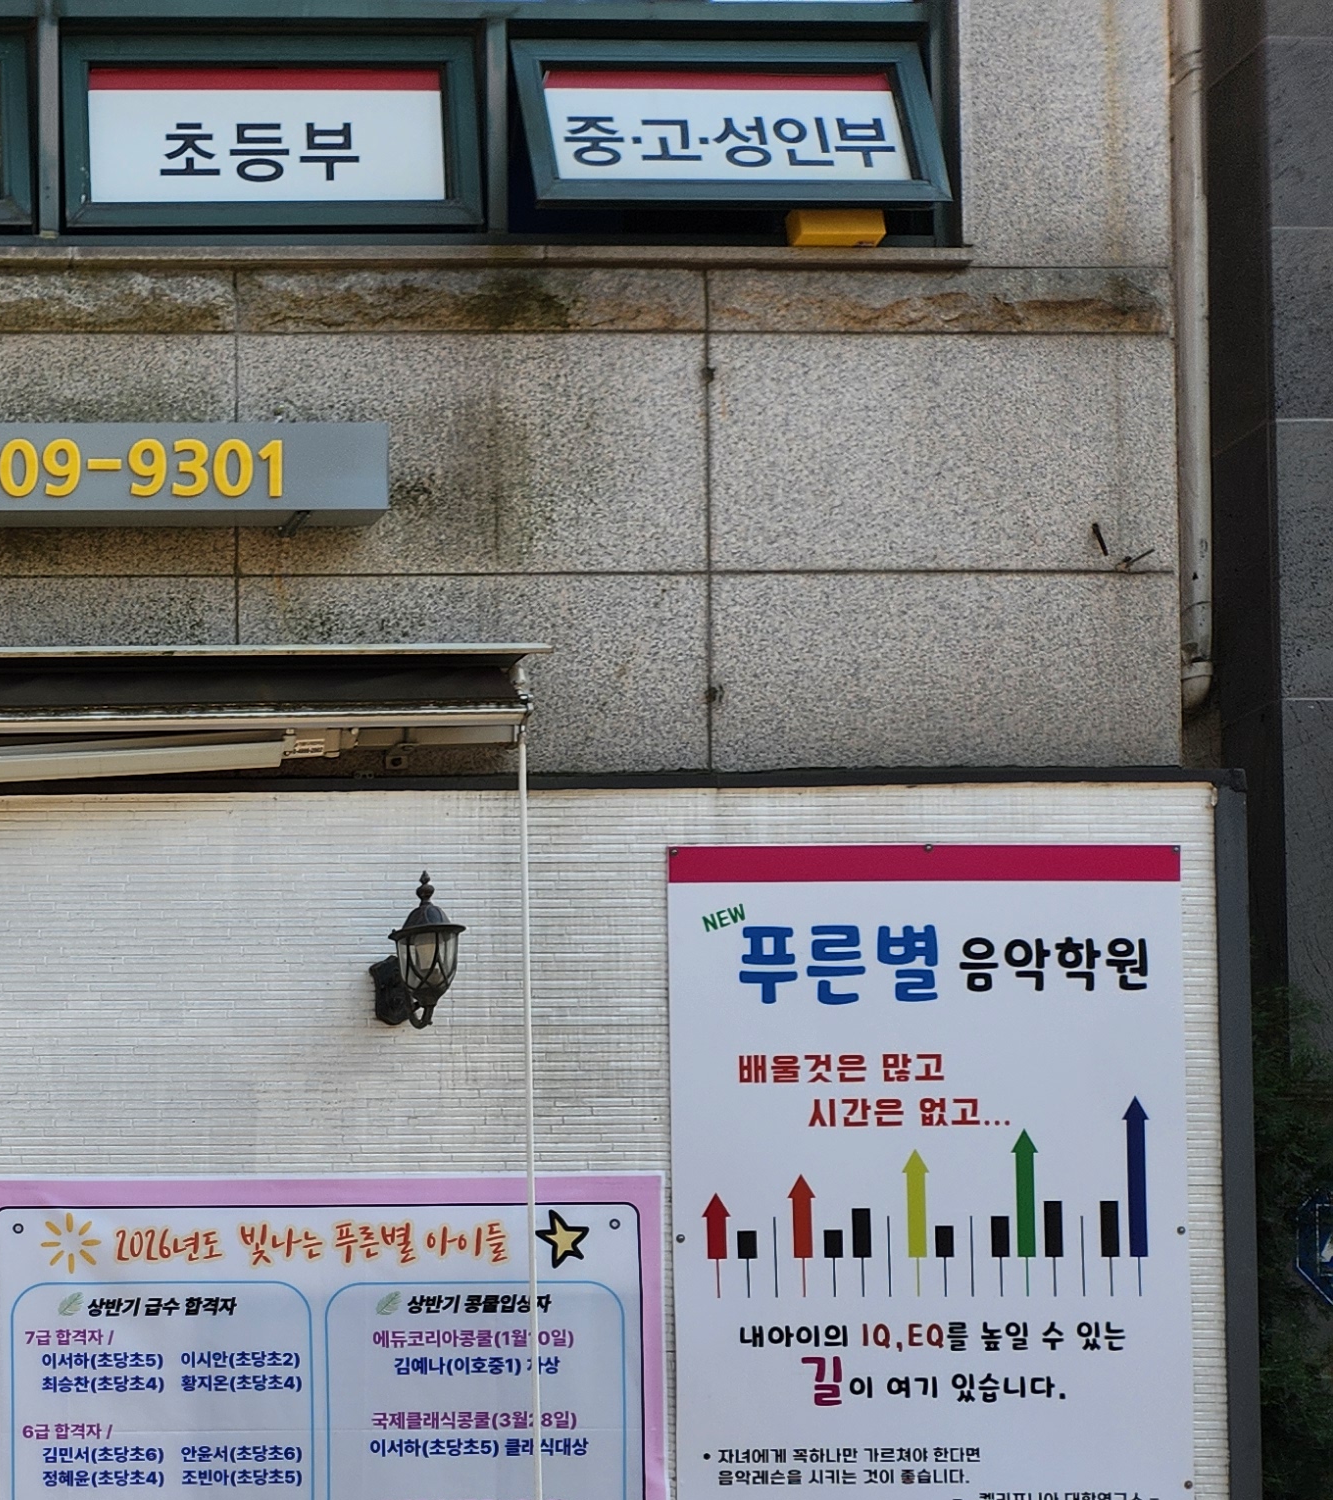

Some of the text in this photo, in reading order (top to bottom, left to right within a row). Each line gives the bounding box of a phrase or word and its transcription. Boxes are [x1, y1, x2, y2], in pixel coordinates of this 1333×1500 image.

[160, 123, 359, 182] 초등부
[702, 904, 746, 932] NEW
[739, 925, 1148, 1005] 푸른별 음악학원
[739, 1054, 944, 1083] 배울것은 많고
[809, 1098, 1010, 1127] 시간은 없고...
[115, 1223, 508, 1264] 2026년도 빛나는 푸른별 아이들
[87, 1297, 237, 1316] 상반기 급수 합격자
[407, 1295, 460, 1313] 상반기
[25, 1329, 103, 1345] 7급 합격자
[373, 1330, 574, 1348] 에듀코리아콩쿨(1월0일)
[740, 1322, 1125, 1352] 내아이의 IQ,EQ를 높일 수 있는
[42, 1351, 300, 1370] 이서하(초당초5) 이시안(초당초2)
[395, 1357, 521, 1376] 김예나(이호중1)
[42, 1375, 302, 1393] 최승찬(초당초4) 황지온(초당초4)
[887, 1377, 937, 1398] 여기
[952, 1373, 1065, 1403] 있습니다.
[23, 1424, 102, 1440] 6급 합격자
[43, 1445, 302, 1464] 김민서(초당초6) 안윤서(초당초6)
[370, 1439, 499, 1457] 이서하(초당초5)
[718, 1447, 980, 1463] 자녀에게 꼭하나만 가르쳐야 한다면
[43, 1469, 302, 1487] 정혜윤(초당초4) 조빈아(초당초5)
[718, 1469, 969, 1485] 음악레슨을 시키는 것이 좋습니다.
